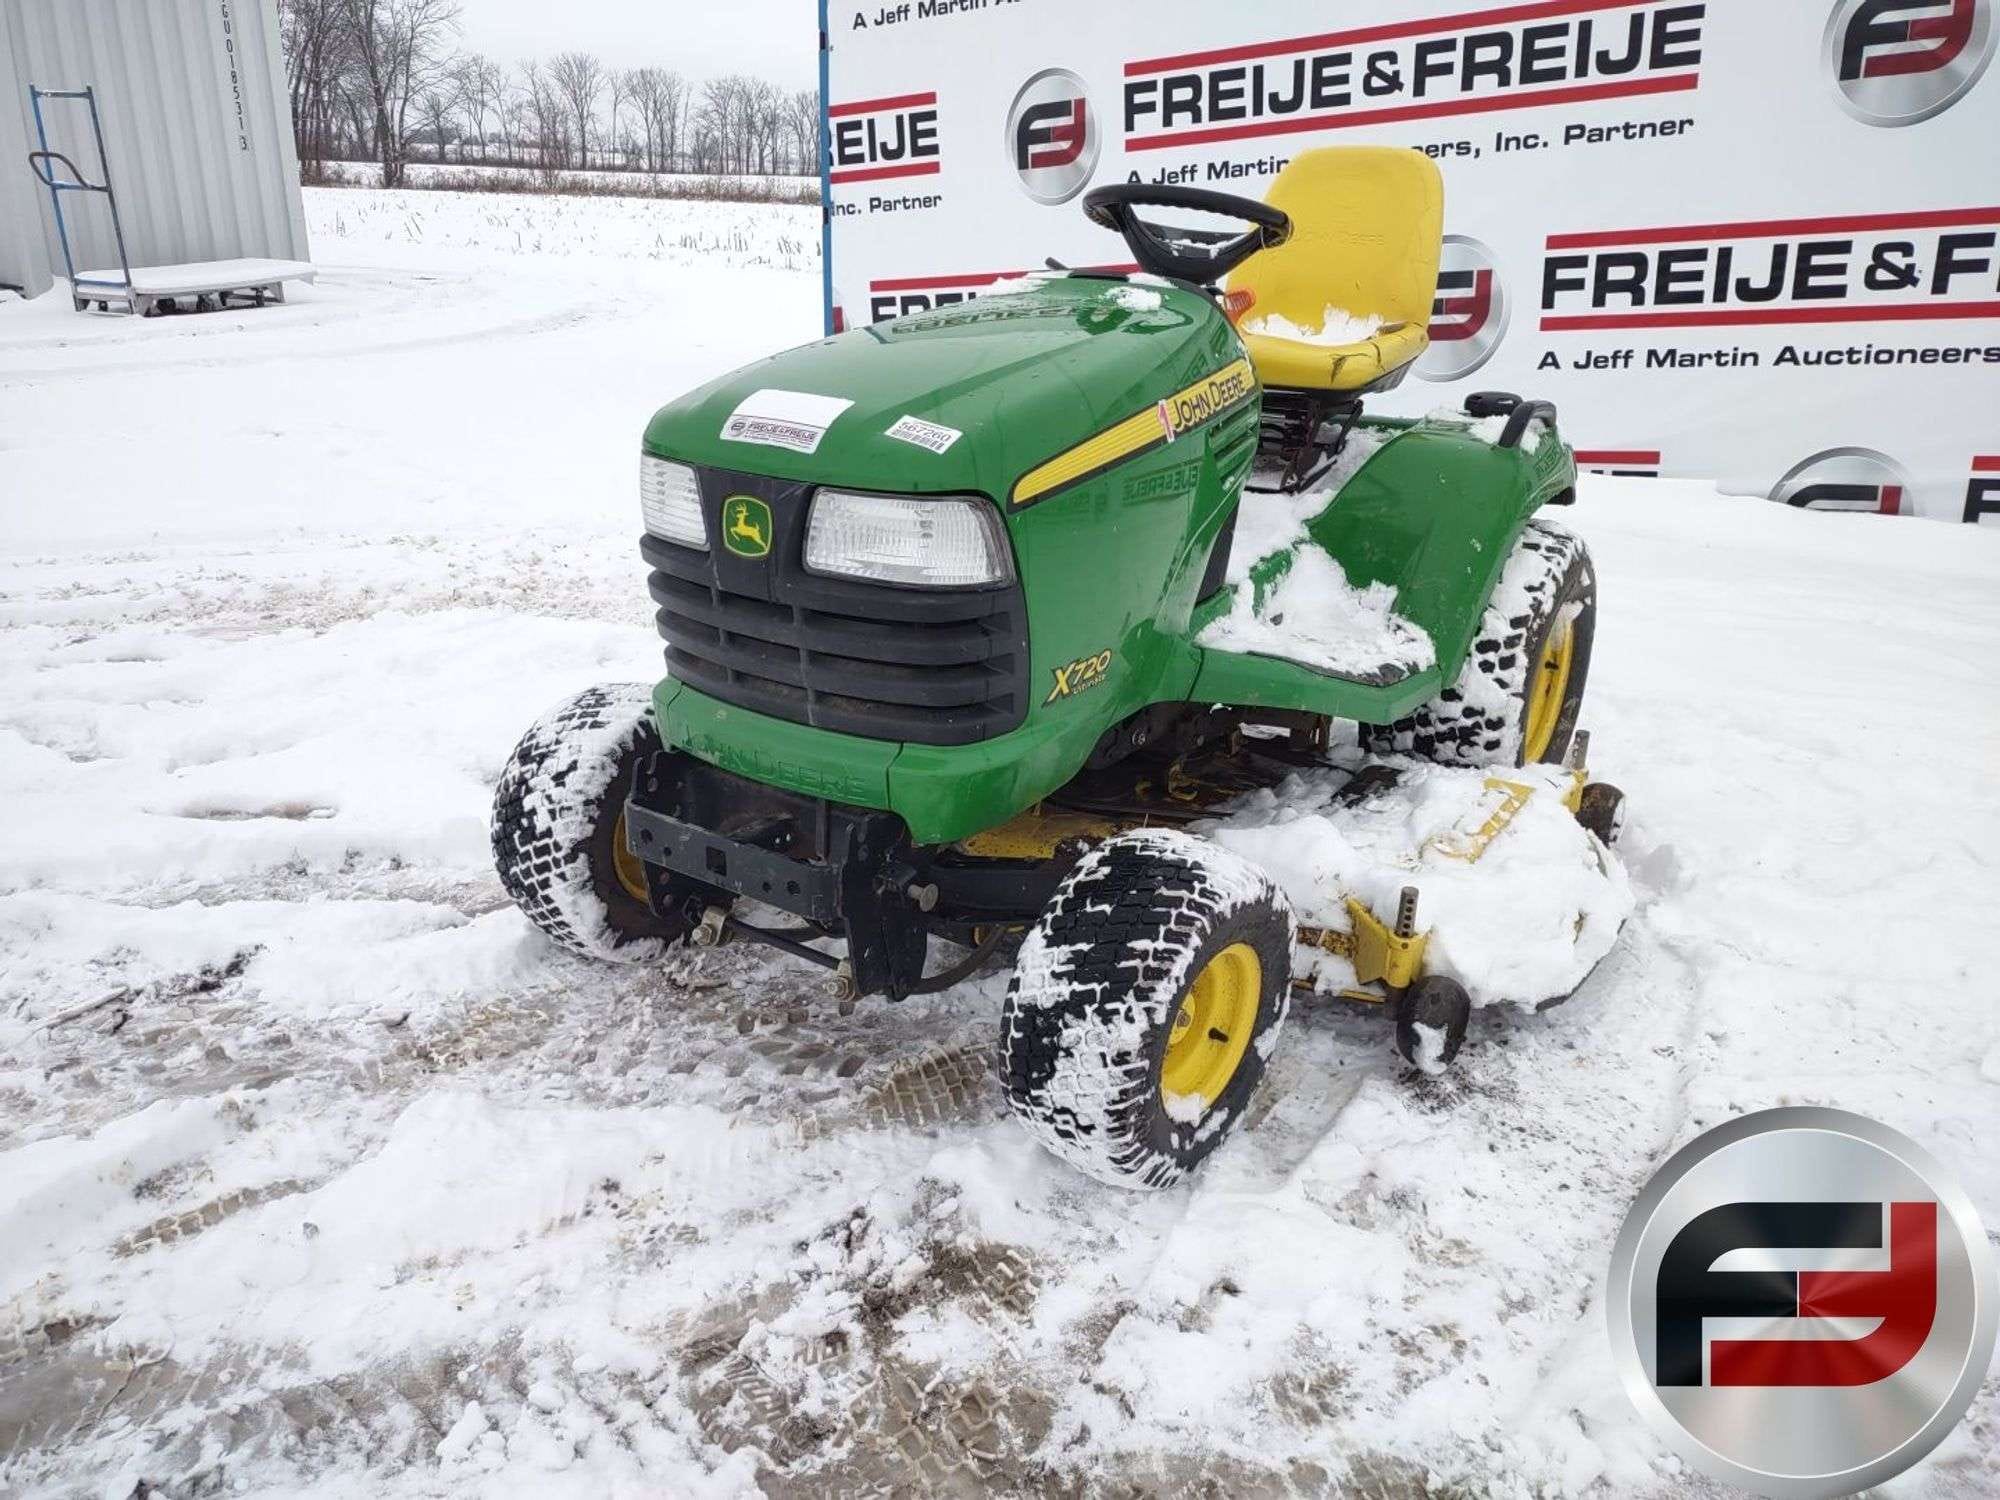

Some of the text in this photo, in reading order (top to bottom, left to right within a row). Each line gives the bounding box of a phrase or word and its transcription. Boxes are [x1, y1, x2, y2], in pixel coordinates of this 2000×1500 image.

[853, 12, 867, 30] A
[875, 4, 912, 26] Jeff
[1124, 3, 1706, 133] FREIJE & FREIJE
[826, 109, 941, 167] EIJE
[1152, 164, 1199, 185] Jeff
[1495, 131, 1549, 153] Inc.
[1563, 117, 1695, 147] Partner
[869, 194, 943, 214] Partner
[1541, 239, 1853, 310] FREIJE
[1863, 241, 1920, 291] &
[1537, 351, 1561, 370] A
[1573, 349, 1635, 370] Jeff
[1646, 346, 1760, 369] Martin
[1173, 391, 1212, 429] JOHN
[1209, 372, 1245, 408] DEERE
[1042, 648, 1112, 707] X720
